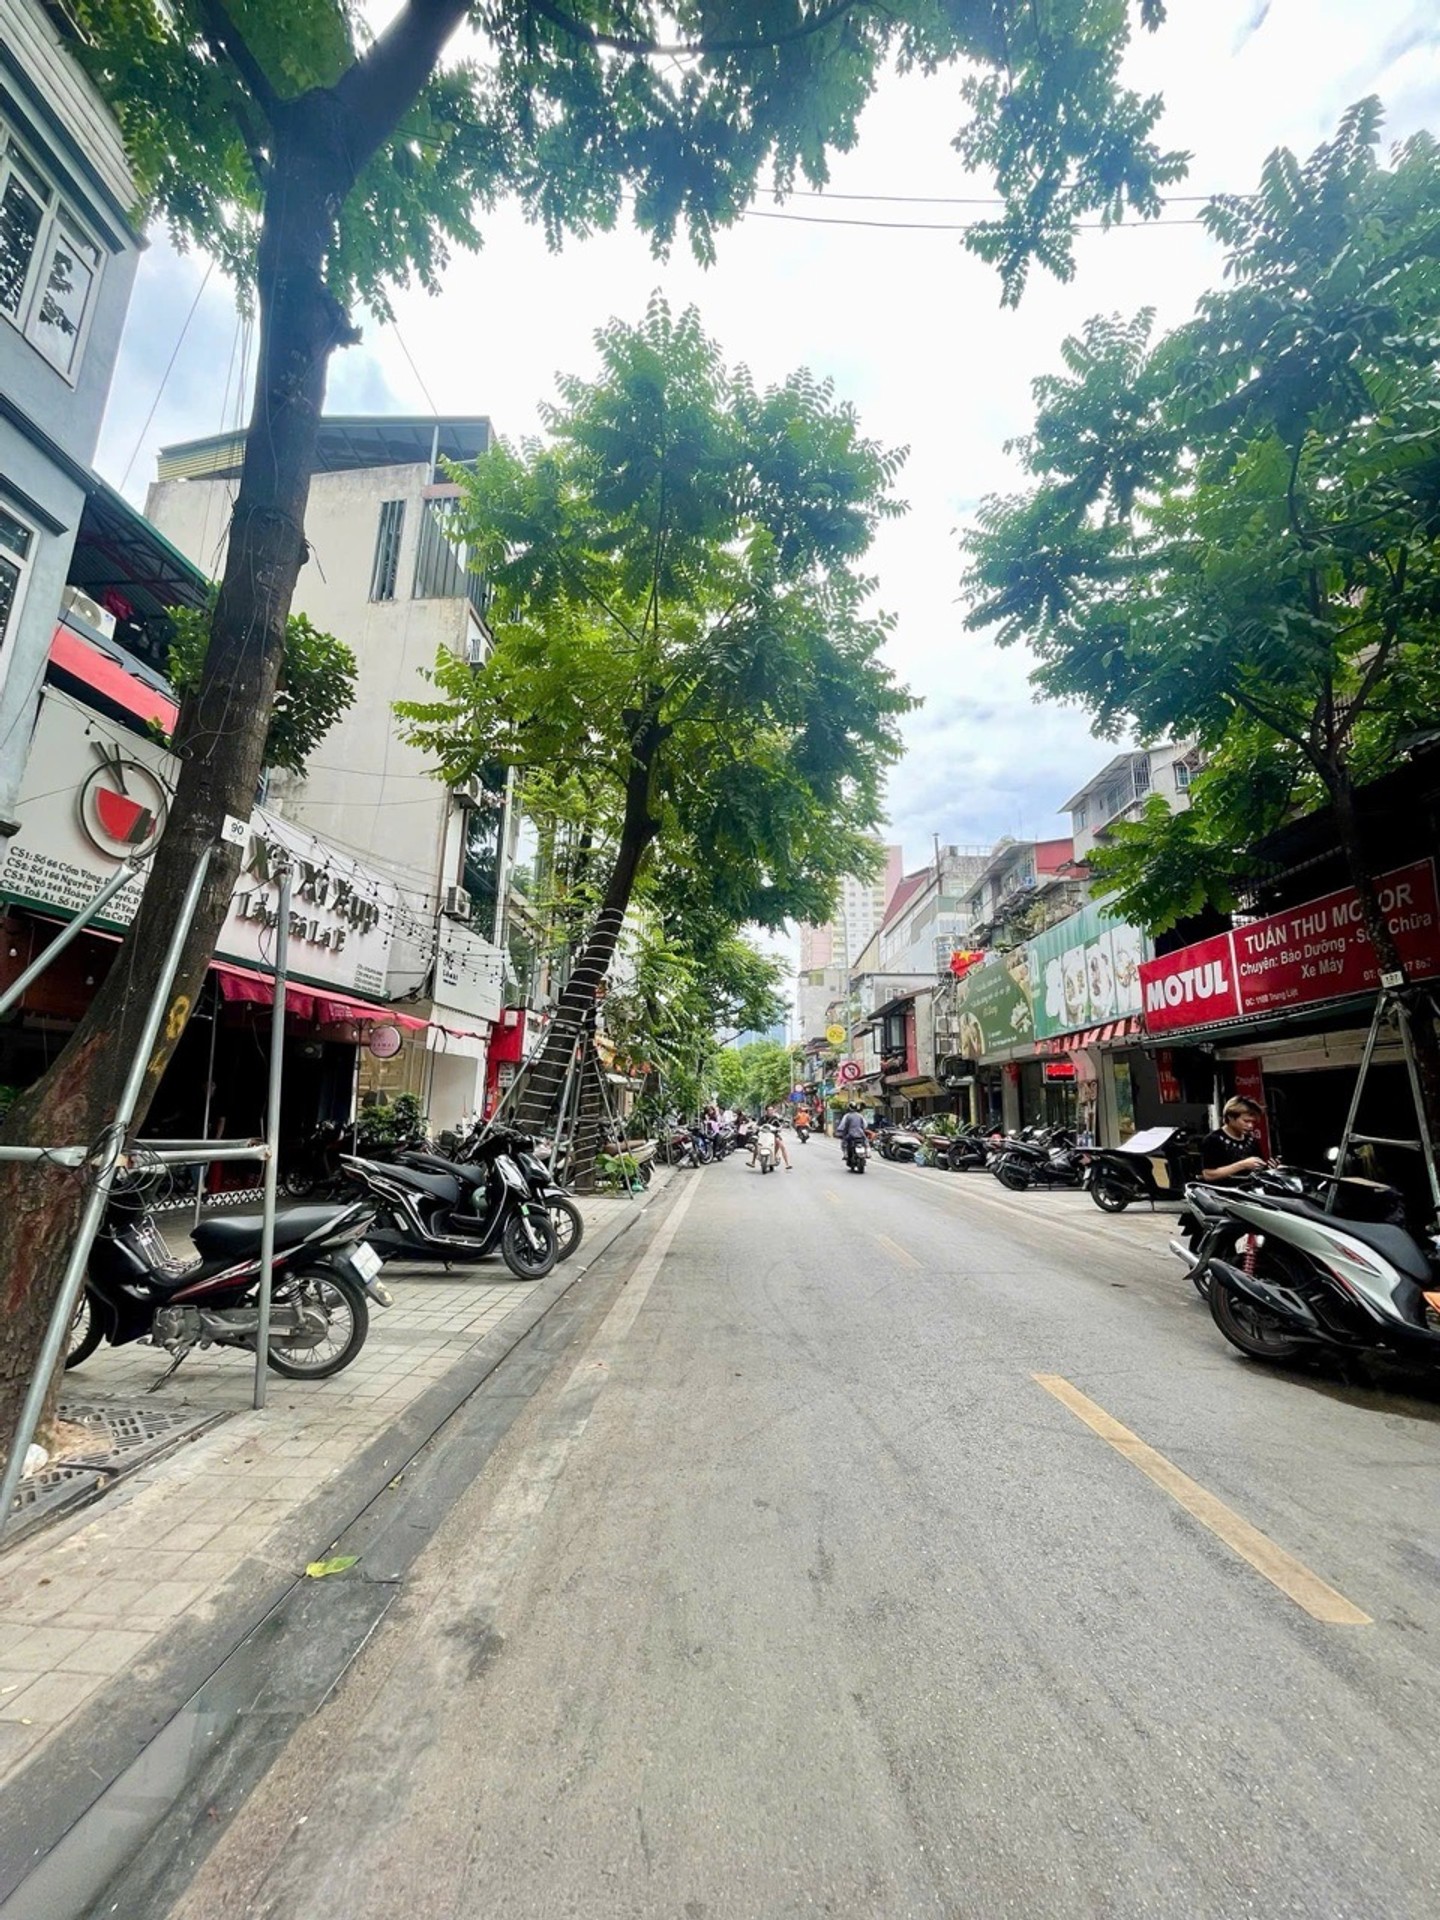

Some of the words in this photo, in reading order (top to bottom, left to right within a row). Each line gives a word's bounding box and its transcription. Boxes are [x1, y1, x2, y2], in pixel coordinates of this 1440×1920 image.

[231, 822, 244, 835] 90
[10, 846, 33, 861] CS1:
[7, 857, 29, 871] CS2:
[3, 868, 26, 882] CS3:
[1291, 913, 1326, 940] THU
[1333, 883, 1414, 926] MOOR
[1240, 957, 1279, 976] Chuyên:
[1304, 937, 1346, 959] Dưỡng
[1388, 912, 1432, 934] Chữa
[1301, 964, 1317, 980] Xe
[1319, 957, 1344, 975] Máy
[1147, 960, 1228, 1012] MOTUL
